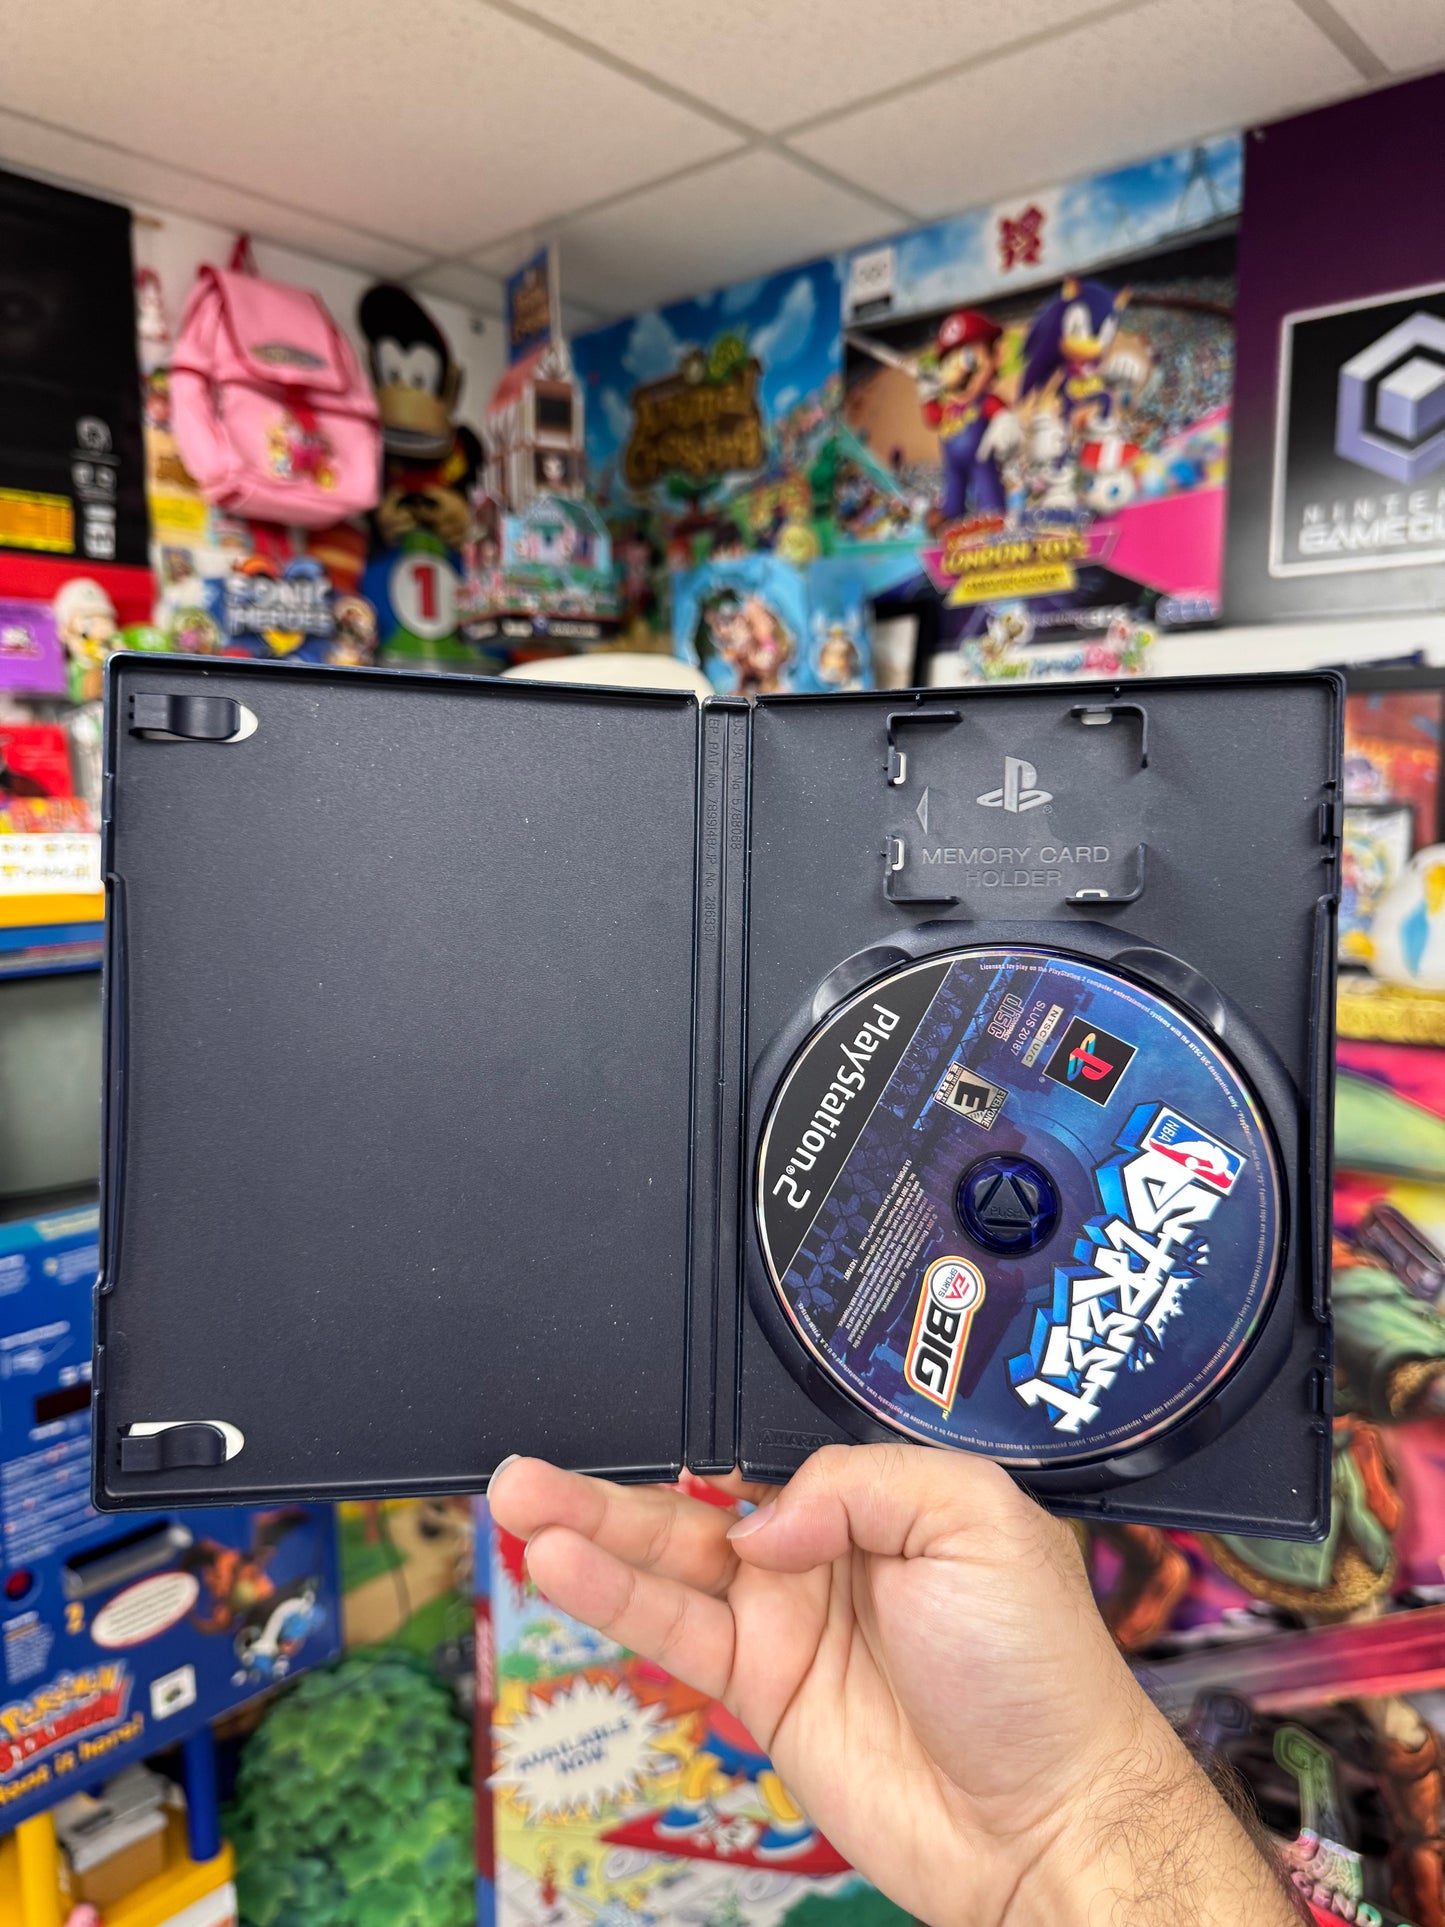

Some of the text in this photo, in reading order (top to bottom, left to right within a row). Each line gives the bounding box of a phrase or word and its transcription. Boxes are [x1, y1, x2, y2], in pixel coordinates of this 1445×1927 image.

[1299, 511, 1445, 555] GAMEC
[921, 846, 1110, 866] MEMORY CARD
[966, 868, 1063, 887] HOLDER
[1087, 979, 1113, 992] computer
[1113, 990, 1150, 1012] entertainment
[1001, 1012, 1021, 1042] COMPACT
[1149, 1010, 1171, 1027] systems
[1008, 999, 1045, 1056] SLUS 20187
[1024, 1008, 1059, 1063] NTSC U/C
[1170, 1026, 1182, 1037] with
[1180, 1035, 1190, 1044] the
[1188, 1042, 1203, 1057] NTSC
[1200, 1055, 1211, 1066] U/C
[934, 1062, 959, 1101] ESRB
[1208, 1066, 1230, 1095] designation
[953, 1080, 990, 1110] E
[980, 1089, 1007, 1127] EVERYONE
[1157, 1119, 1180, 1143] NBA
[896, 1166, 908, 1183] SPORTS
[895, 1197, 903, 1206] NBA
[901, 1197, 911, 1210] whole
[912, 1188, 924, 1206] property
[917, 1197, 928, 1214] product
[873, 1205, 887, 1225] Electronic
[905, 1211, 913, 1220] NBA
[921, 1212, 930, 1221] NBA
[990, 1206, 1022, 1217] PUSH
[899, 1220, 916, 1243] trademarks,
[916, 1221, 925, 1230] and
[858, 1237, 869, 1250] brand.
[882, 1230, 893, 1246] without
[906, 1229, 920, 1250] individual
[914, 1230, 929, 1252] Electronic
[868, 1243, 877, 1255] rights
[873, 1251, 881, 1263] prior
[883, 1250, 891, 1259] and
[887, 1244, 902, 1268] copyrighted
[901, 1249, 909, 1259] NBA
[908, 1251, 917, 1261] Arts
[1256, 1234, 1265, 1264] registered
[858, 1254, 871, 1273] reserved.
[865, 1262, 876, 1276] written
[892, 1258, 904, 1275] member
[904, 1261, 912, 1269] Inc.
[869, 1265, 882, 1286] respective
[879, 1267, 890, 1284] designs
[886, 1275, 895, 1286] team
[937, 1267, 957, 1298] SPORTS
[1248, 1265, 1262, 1296] trademarks
[857, 1276, 868, 1293] consent
[861, 1286, 871, 1299] teams
[891, 1279, 901, 1292] rights
[943, 1272, 970, 1298] EA
[849, 1296, 857, 1306] NBA
[869, 1291, 877, 1303] other
[871, 1286, 889, 1314] identifications
[880, 1292, 894, 1312] reserved.
[852, 1307, 860, 1316] may
[865, 1314, 873, 1325] used
[1238, 1304, 1250, 1318] Sony
[847, 1319, 862, 1342] intellectual
[1226, 1318, 1243, 1342] Computer
[852, 1339, 860, 1348] this
[912, 1297, 962, 1394] BIG
[1201, 1342, 1229, 1375] Entertainment
[835, 1358, 864, 1387] Manufactured
[1163, 1382, 1194, 1408] Unauthorized
[878, 1395, 904, 1415] applicable
[910, 1415, 933, 1429] violation
[947, 1430, 958, 1438] may
[960, 1435, 975, 1443] game
